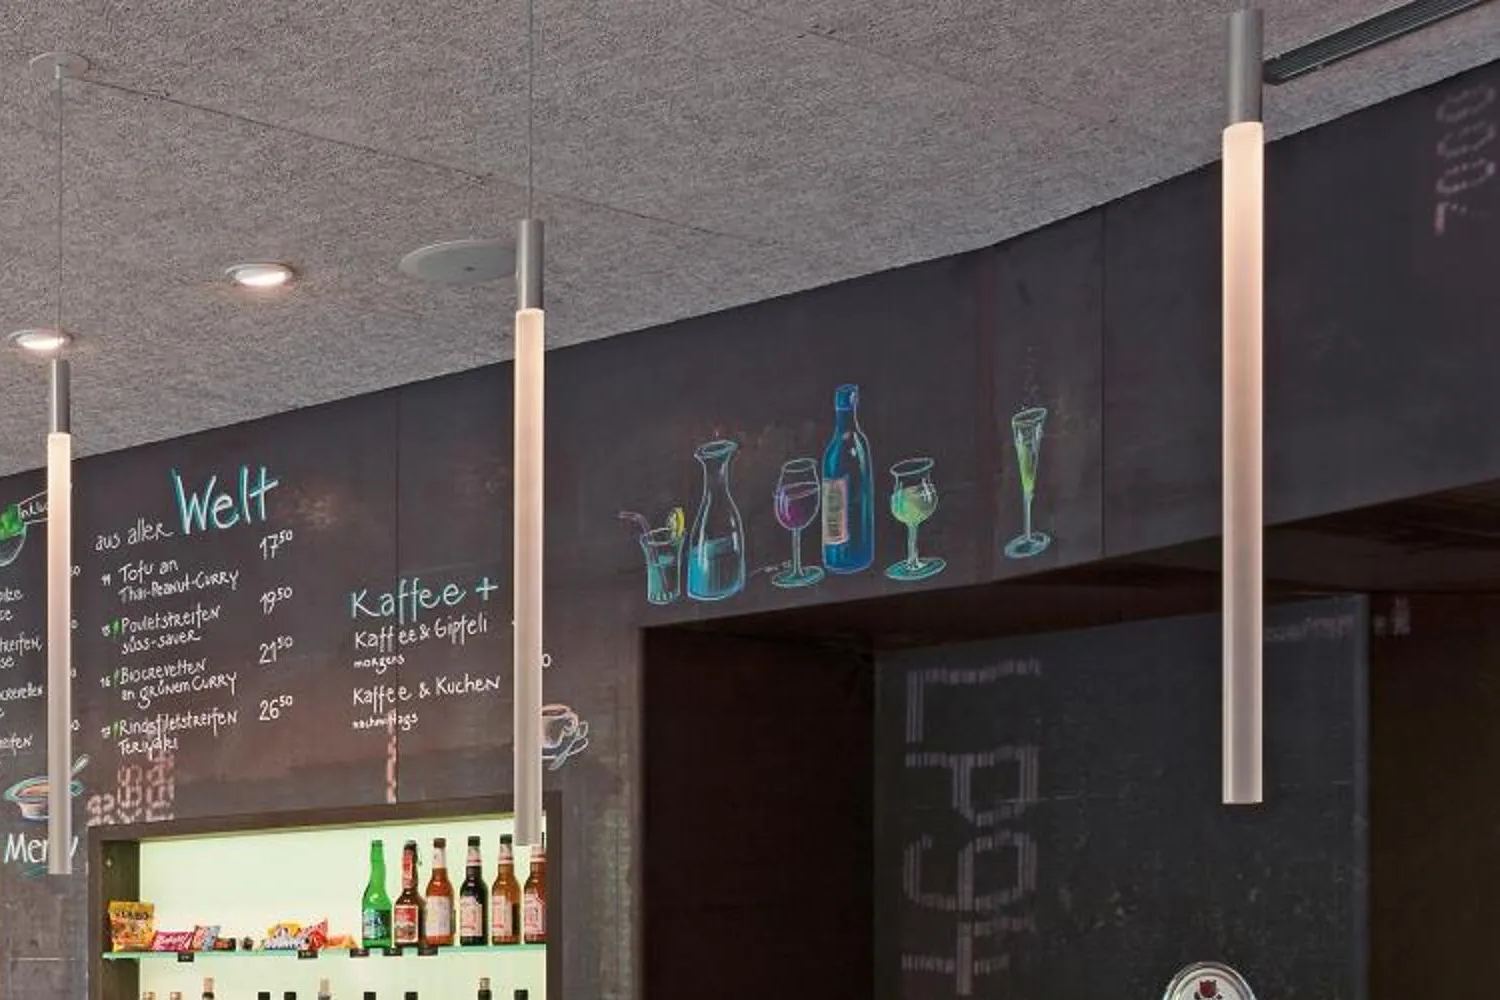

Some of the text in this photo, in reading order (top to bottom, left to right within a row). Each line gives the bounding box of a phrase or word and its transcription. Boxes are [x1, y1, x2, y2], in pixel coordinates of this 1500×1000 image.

[95, 532, 121, 551] aus
[170, 465, 280, 535] Welt
[118, 560, 153, 585] Tofu
[159, 559, 179, 575] an
[121, 602, 221, 635] Pouletstreifen
[352, 577, 467, 624] Kaffee
[355, 625, 415, 652] Kaffee
[434, 611, 488, 645] Gipfeli
[191, 672, 238, 696] Curry
[353, 685, 412, 713] Kaffee
[436, 673, 500, 697] Kuchen
[4, 832, 79, 864] Men
